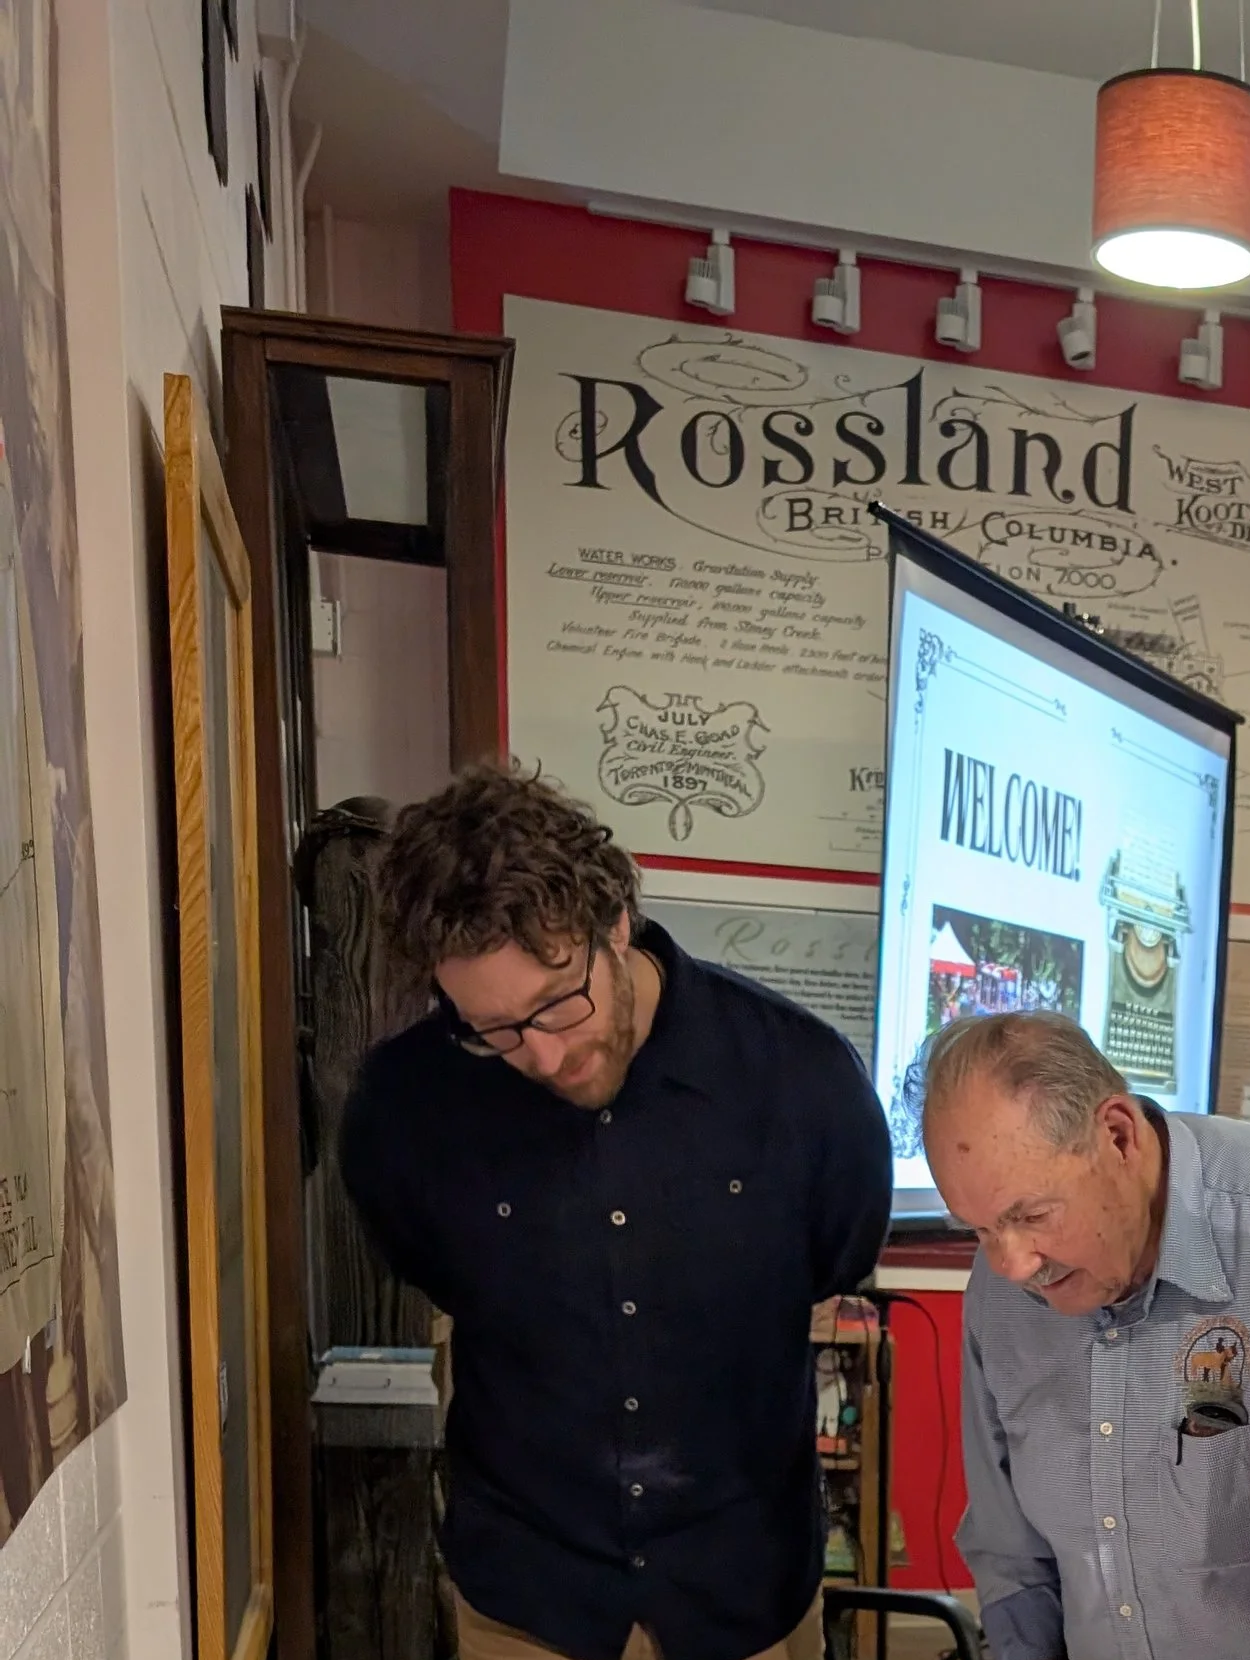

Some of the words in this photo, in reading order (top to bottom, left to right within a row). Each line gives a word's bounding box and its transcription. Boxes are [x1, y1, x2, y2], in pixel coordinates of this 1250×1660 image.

[556, 368, 1138, 516] Rossland
[1153, 444, 1245, 496] WEST
[578, 548, 624, 564] WATER
[657, 710, 710, 727] JULY
[663, 774, 708, 792] 1897
[940, 747, 1082, 882] WELCOME!
